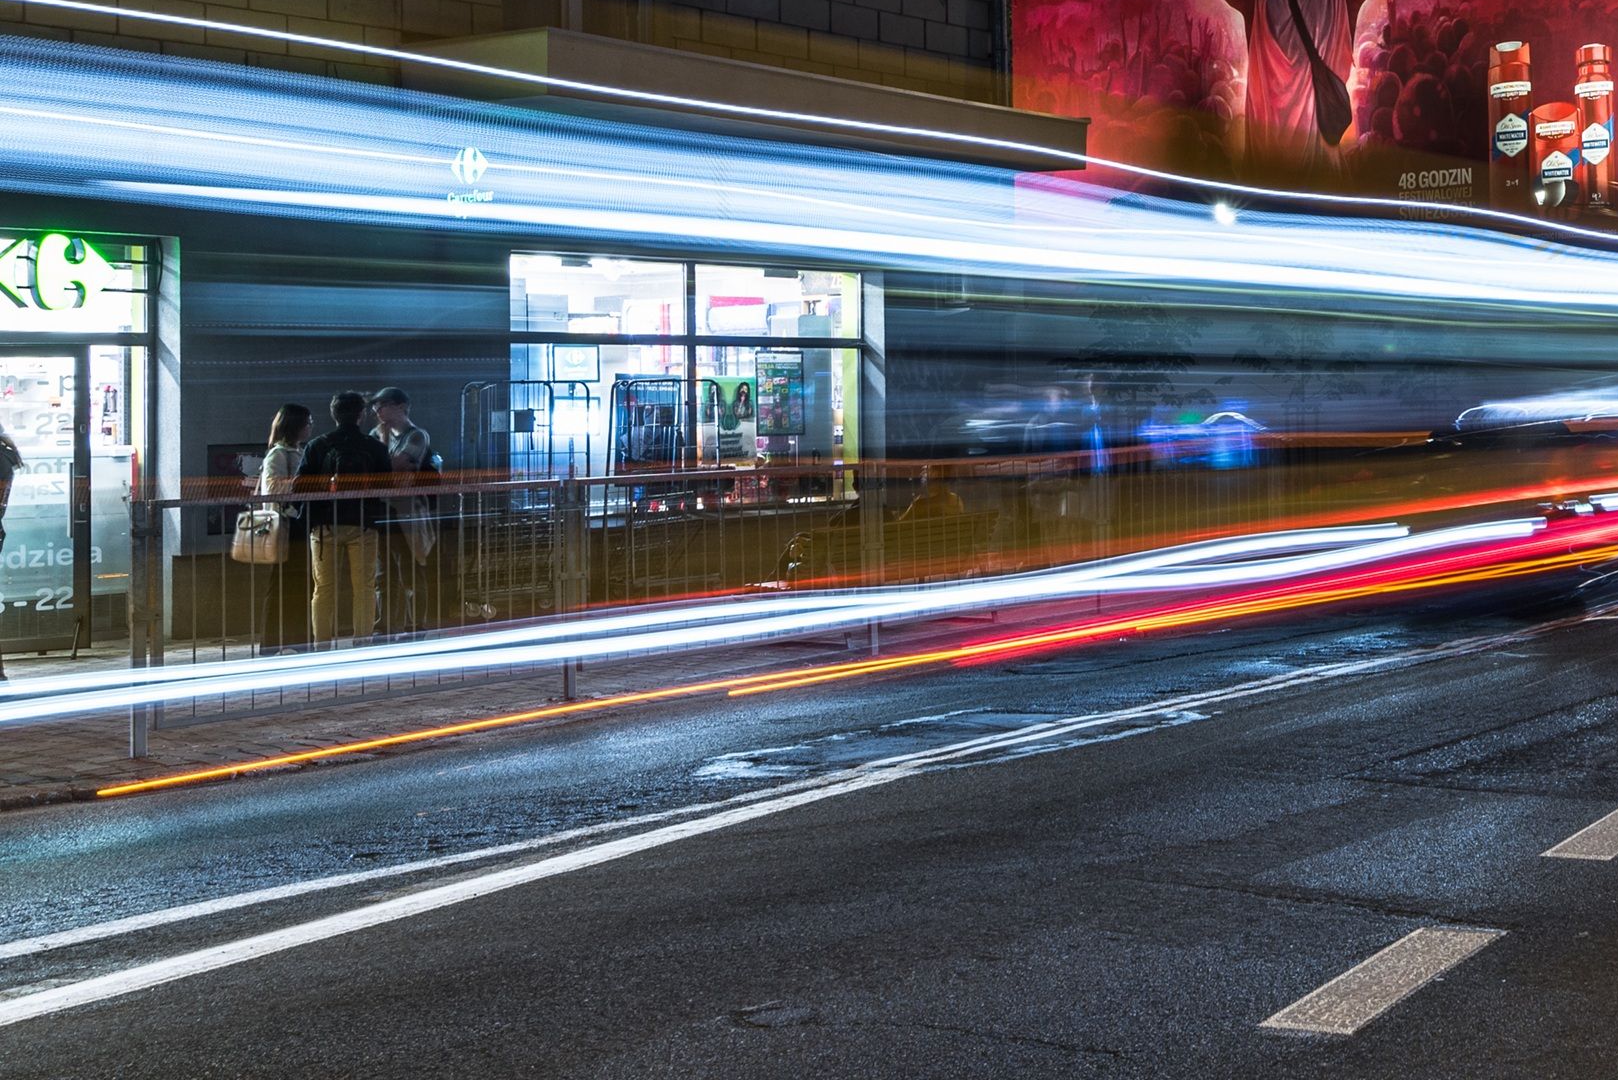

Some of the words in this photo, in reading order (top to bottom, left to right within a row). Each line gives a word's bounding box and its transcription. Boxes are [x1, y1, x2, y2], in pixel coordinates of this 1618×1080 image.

[1398, 172, 1416, 190] 48
[1418, 167, 1472, 188] GODZIN
[1398, 186, 1472, 201] FESTIWALOWEJ
[35, 586, 74, 611] 22
